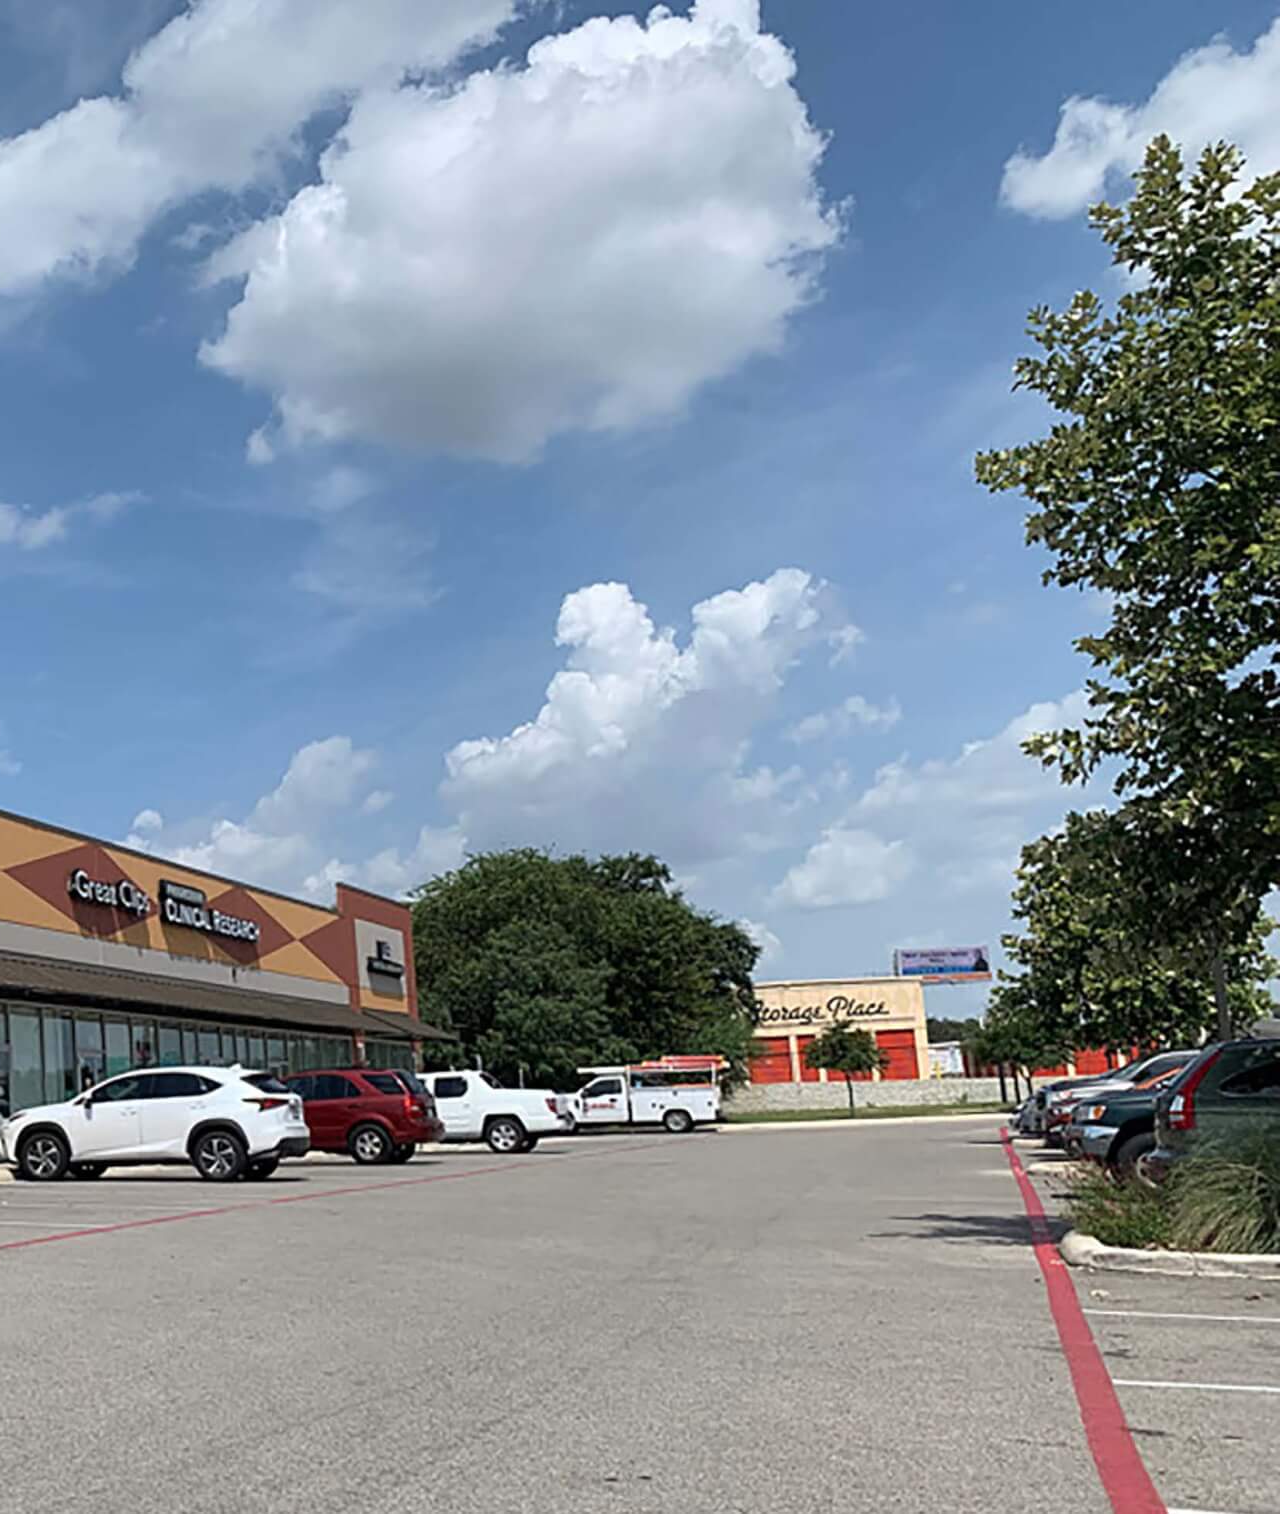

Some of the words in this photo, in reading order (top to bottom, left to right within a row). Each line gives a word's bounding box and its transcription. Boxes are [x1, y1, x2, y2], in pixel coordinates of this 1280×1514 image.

[75, 870, 118, 906] Great
[165, 898, 212, 930] CLINICAL
[826, 996, 890, 1019] Place
